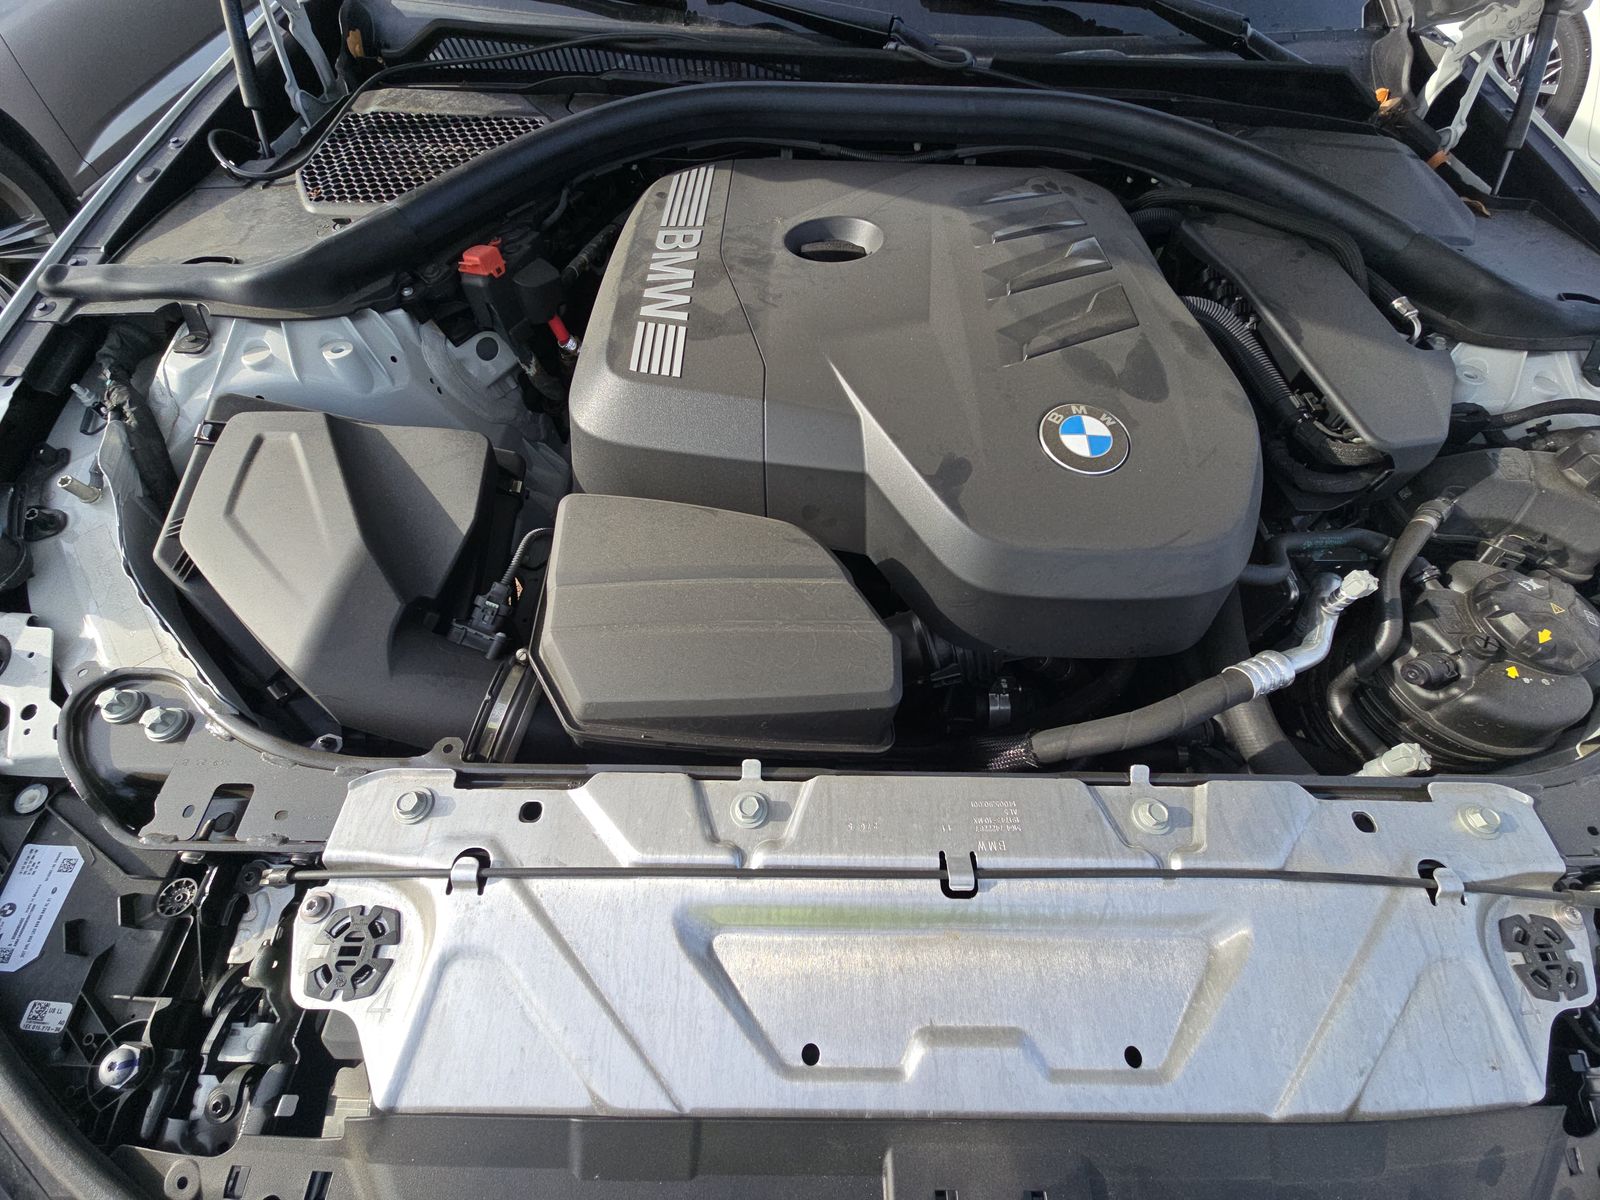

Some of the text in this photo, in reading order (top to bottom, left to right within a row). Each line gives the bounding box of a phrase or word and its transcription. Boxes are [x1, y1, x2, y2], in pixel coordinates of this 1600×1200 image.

[640, 229, 703, 321] BMW
[1047, 405, 1117, 427] BMW
[977, 840, 1007, 852] BMW
